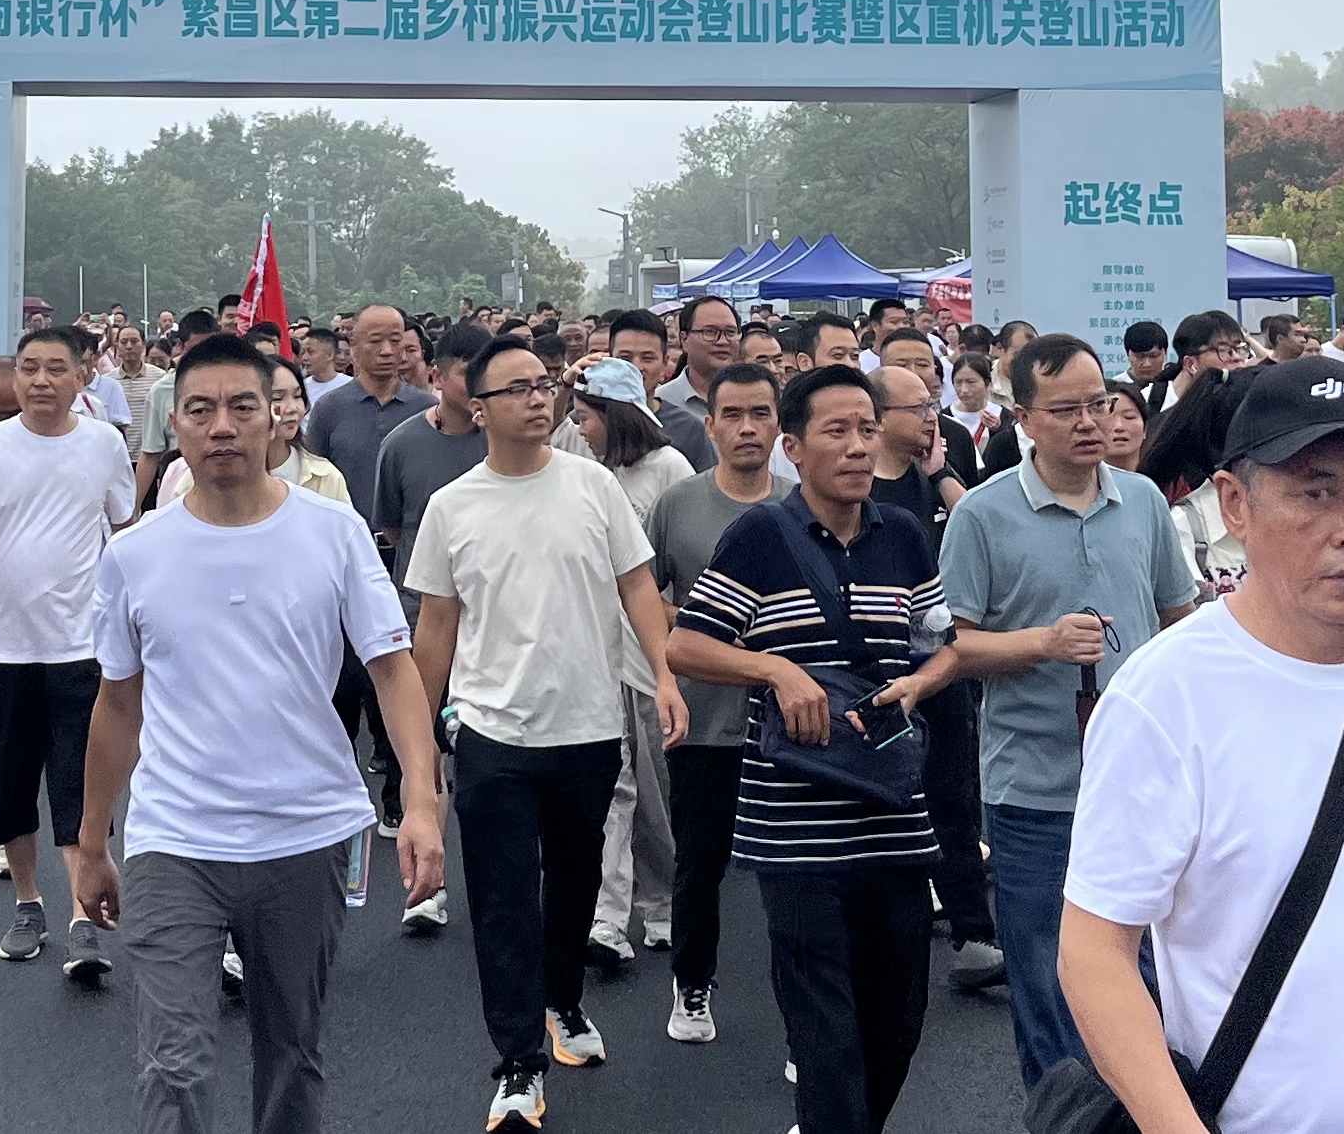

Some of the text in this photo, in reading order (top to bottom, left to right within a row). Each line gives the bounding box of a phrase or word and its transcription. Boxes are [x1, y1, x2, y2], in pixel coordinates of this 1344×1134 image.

[1064, 181, 1183, 225] 起终点
[1102, 265, 1144, 275] 指导单位
[1091, 282, 1155, 293] 芜湖市体育局
[1103, 300, 1145, 310] 主办单位
